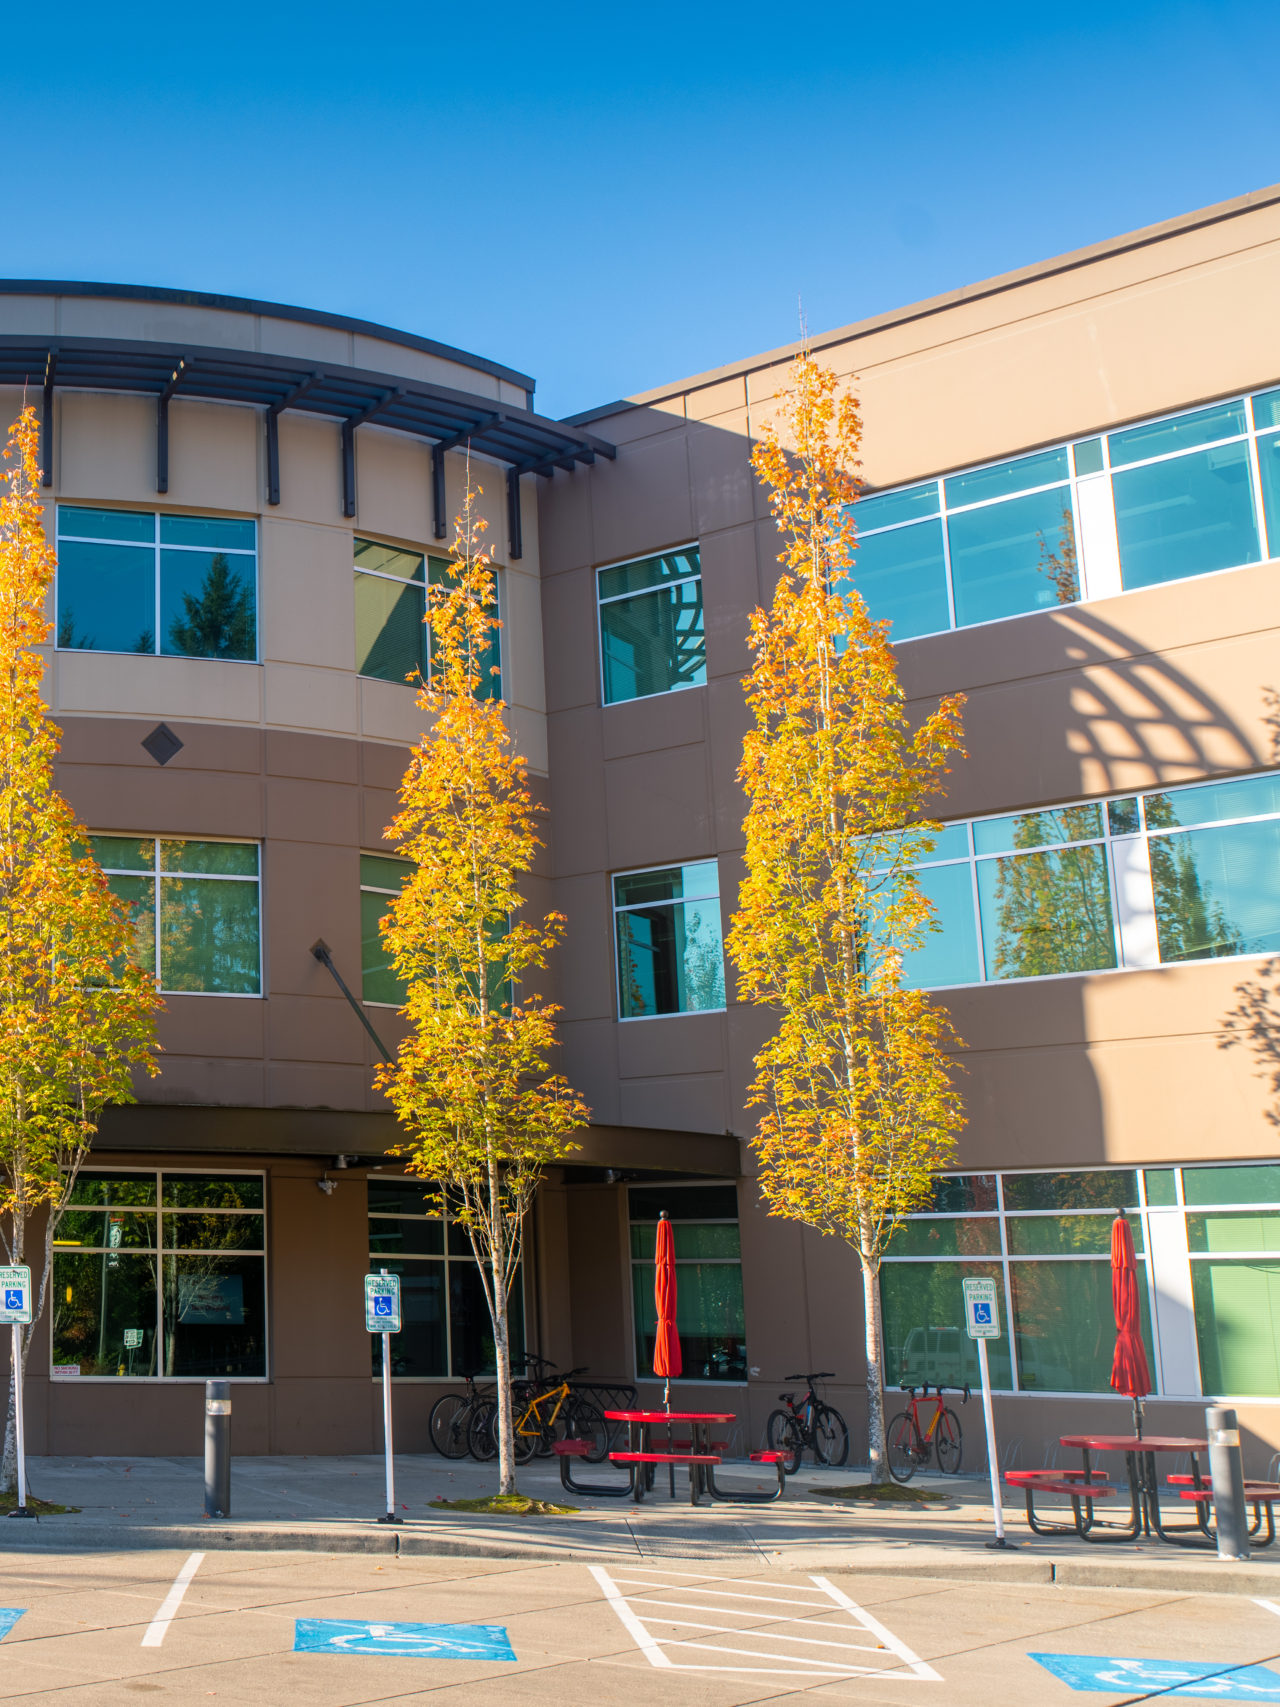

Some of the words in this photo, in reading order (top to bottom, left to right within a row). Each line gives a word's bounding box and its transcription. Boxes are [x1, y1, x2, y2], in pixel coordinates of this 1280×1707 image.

[0, 1271, 28, 1279] RESERVED
[966, 1283, 993, 1291] RESERVED
[969, 1293, 993, 1301] PARKING
